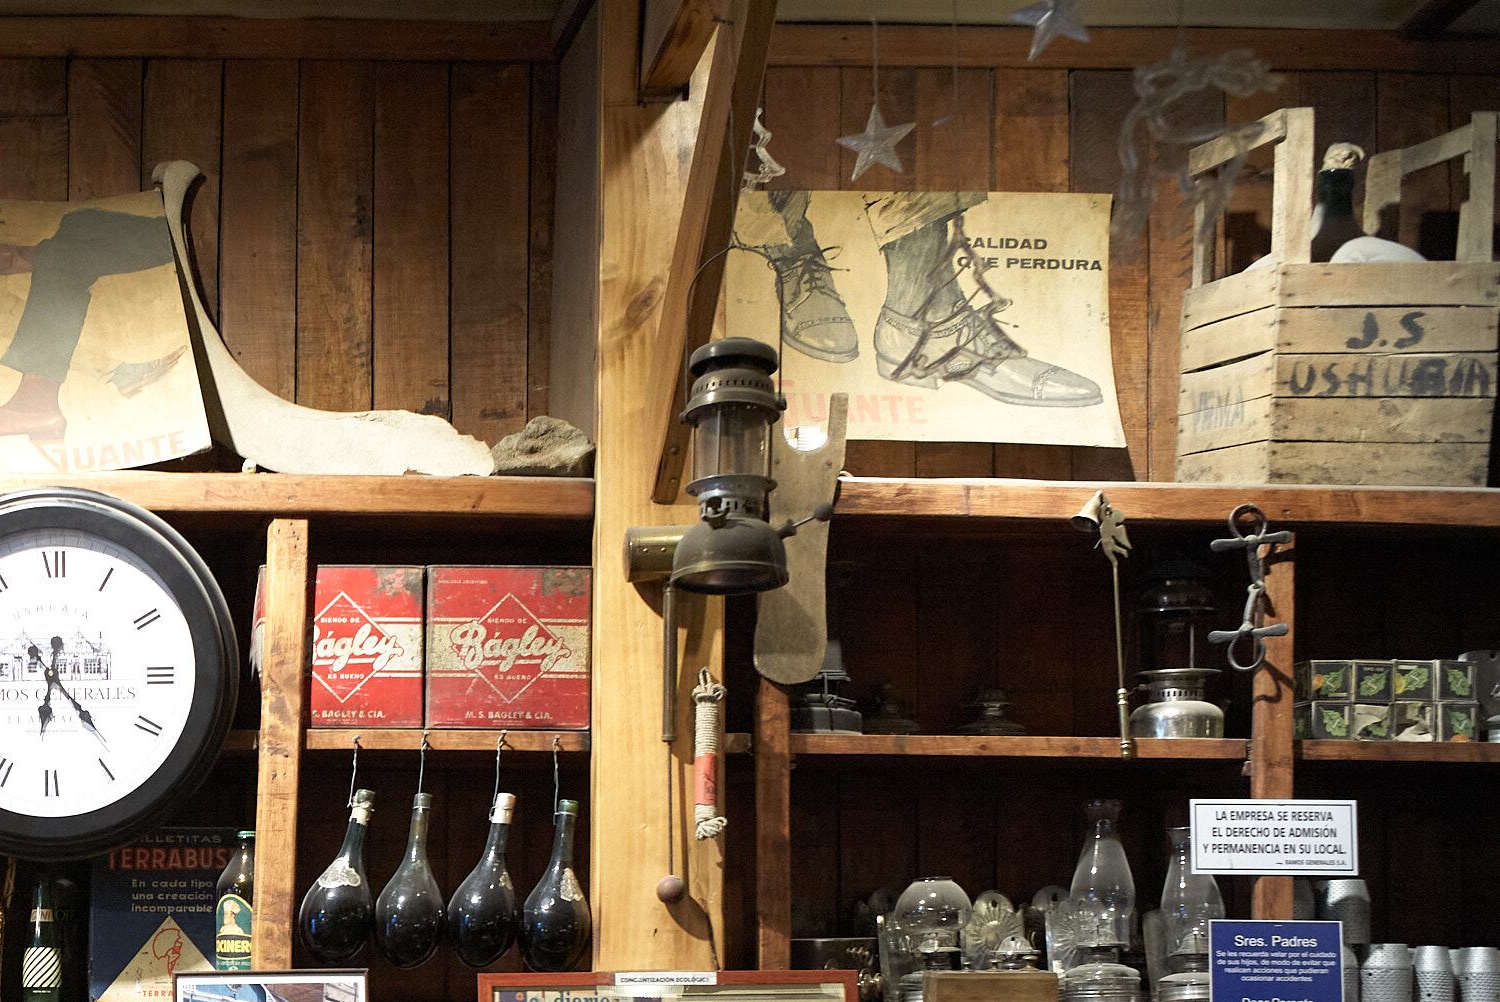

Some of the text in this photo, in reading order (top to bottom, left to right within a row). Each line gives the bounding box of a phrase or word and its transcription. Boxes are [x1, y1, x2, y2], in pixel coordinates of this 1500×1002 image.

[1006, 258, 1103, 272] PERDURA
[450, 621, 571, 673] Bágley
[321, 710, 387, 719] BAGLEY & CIA.
[488, 711, 523, 720] BAGLEY
[525, 711, 532, 719] &
[534, 711, 553, 720] CIA.
[1215, 811, 1333, 822] LA EMPRESA SE RESERVA
[1212, 825, 1337, 838] EL DERECHO DE ADMISIÓN
[1203, 843, 1347, 855] Y PERMANENCIA EN SU LOCAL.
[107, 847, 229, 870] TERRABUS
[131, 879, 213, 890] En cada tipo
[157, 891, 214, 901] creación
[131, 903, 213, 914] incomparable
[1234, 935, 1317, 948] Sres. Padres
